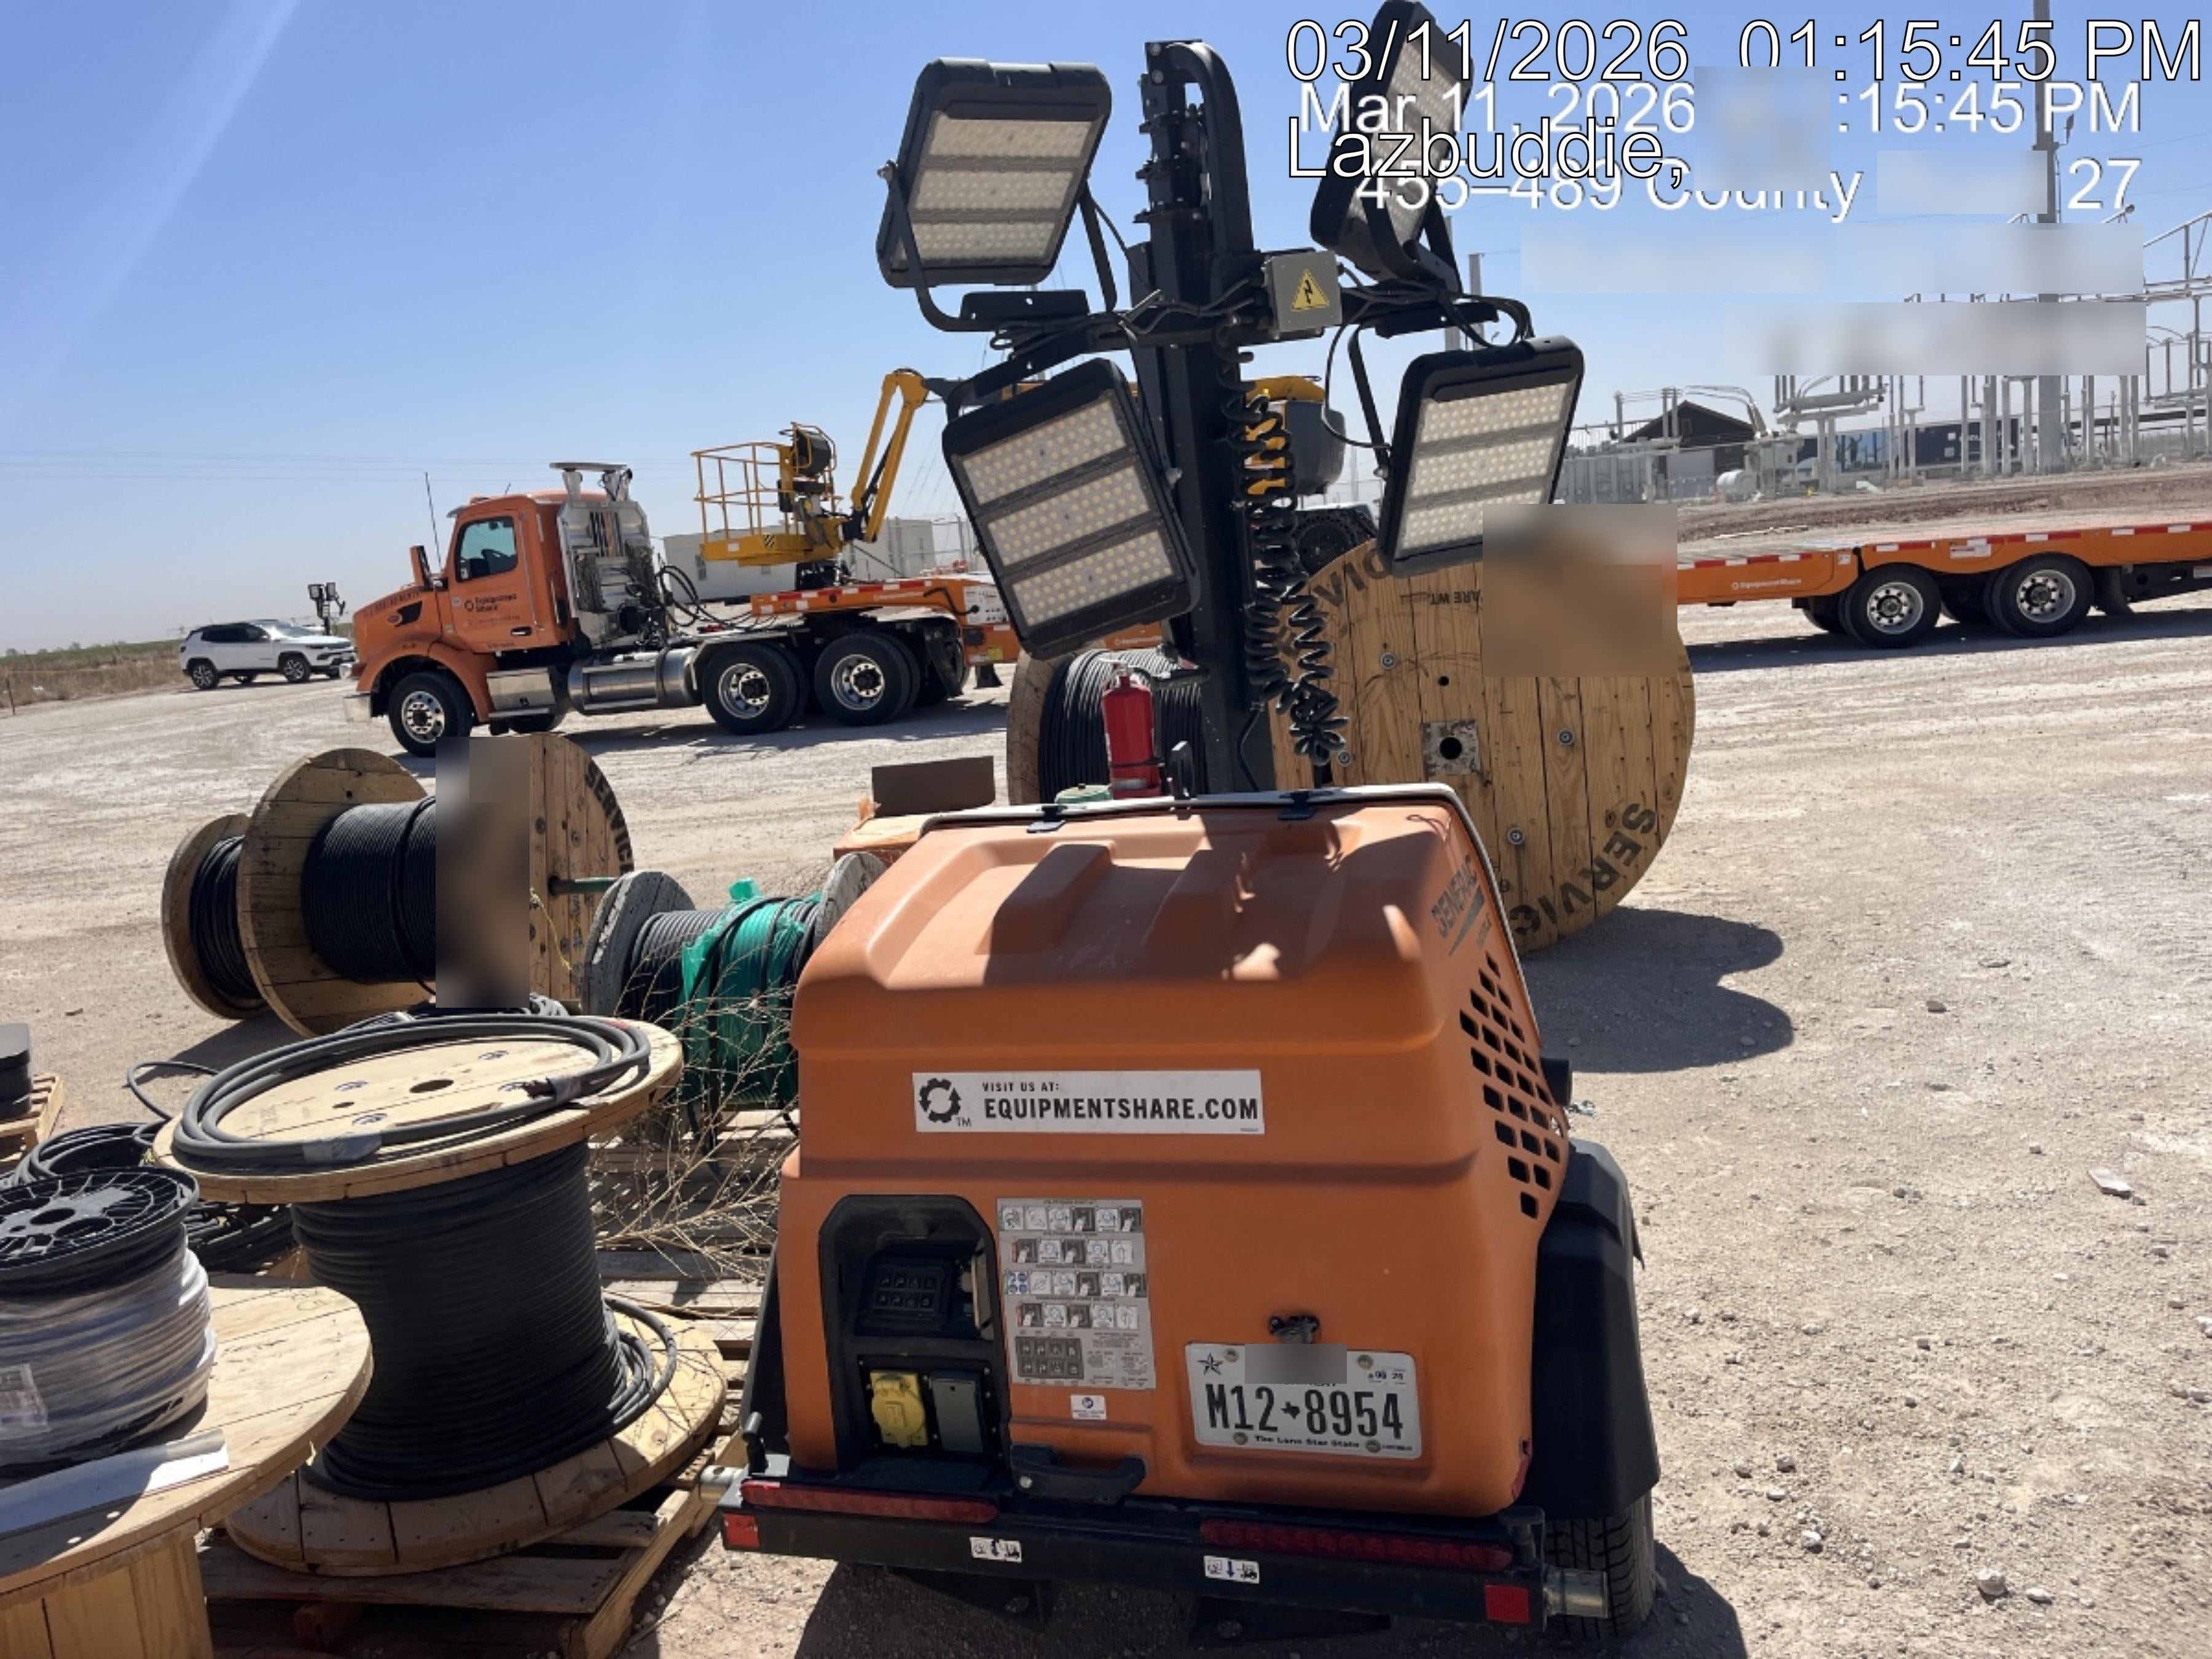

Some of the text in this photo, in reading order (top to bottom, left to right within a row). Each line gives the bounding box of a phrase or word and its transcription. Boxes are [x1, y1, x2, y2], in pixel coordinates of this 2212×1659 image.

[1507, 803, 1657, 935] SERVIC
[982, 1081, 1060, 1092] VISIT US AT:
[983, 1097, 1259, 1122] EQUIPMENTSHARE.COM
[1205, 1382, 1403, 1440] M12 8954
